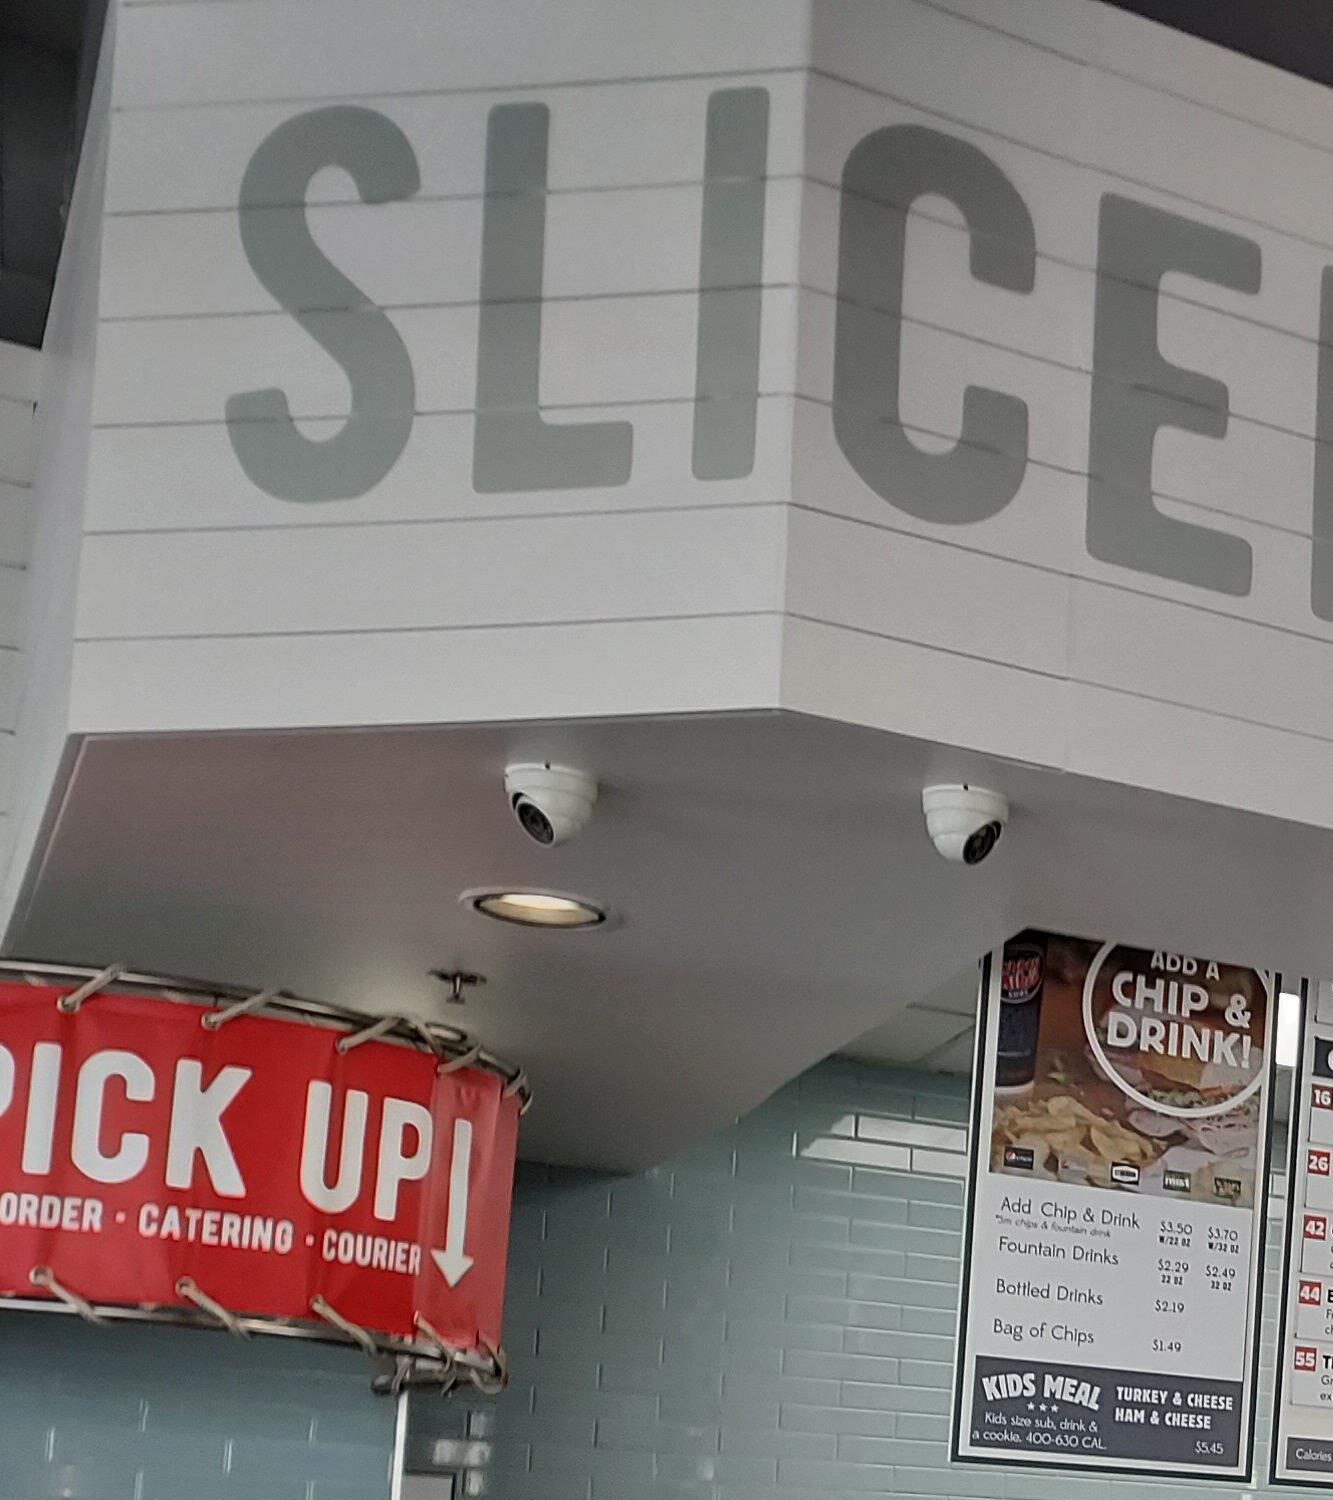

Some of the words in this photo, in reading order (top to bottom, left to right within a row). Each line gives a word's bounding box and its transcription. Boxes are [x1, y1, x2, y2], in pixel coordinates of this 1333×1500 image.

[1150, 951, 1197, 975] ADD
[1205, 962, 1220, 981] A
[1112, 970, 1209, 1018] CHIP
[1224, 993, 1251, 1028] &
[1107, 1011, 1251, 1068] DRINK!
[0, 1041, 253, 1198] ICK
[300, 1080, 432, 1222] UP
[1001, 1197, 1031, 1216] Add
[1040, 1200, 1079, 1224] Chip
[1082, 1207, 1096, 1223] &
[1098, 1208, 1141, 1230] Drink
[1159, 1221, 1193, 1236] $3.50
[1208, 1225, 1239, 1241] $3.70
[1, 1193, 102, 1232] ORDER
[139, 1204, 293, 1254] CATERING
[323, 1229, 421, 1276] COURIER
[999, 1237, 1067, 1261] Fountain
[1072, 1246, 1120, 1266] Drinks
[1158, 1259, 1189, 1274] $2.29
[1205, 1265, 1236, 1280] $2.49
[996, 1279, 1050, 1300] Bottled
[1055, 1285, 1104, 1306] Drinks
[1155, 1300, 1185, 1314] $2.19
[993, 1319, 1023, 1342] Bag
[1030, 1323, 1046, 1340] of
[1051, 1325, 1095, 1345] Chips
[1152, 1339, 1182, 1353] $1.49
[982, 1373, 1036, 1401] KIDS
[1043, 1375, 1102, 1410] MEAL
[1117, 1387, 1168, 1405] TURKEY
[1173, 1391, 1183, 1406] &
[1187, 1392, 1233, 1411] CHEESE
[1114, 1409, 1145, 1425] HAM
[1151, 1411, 1160, 1426] &
[1164, 1413, 1212, 1431] CHEESE
